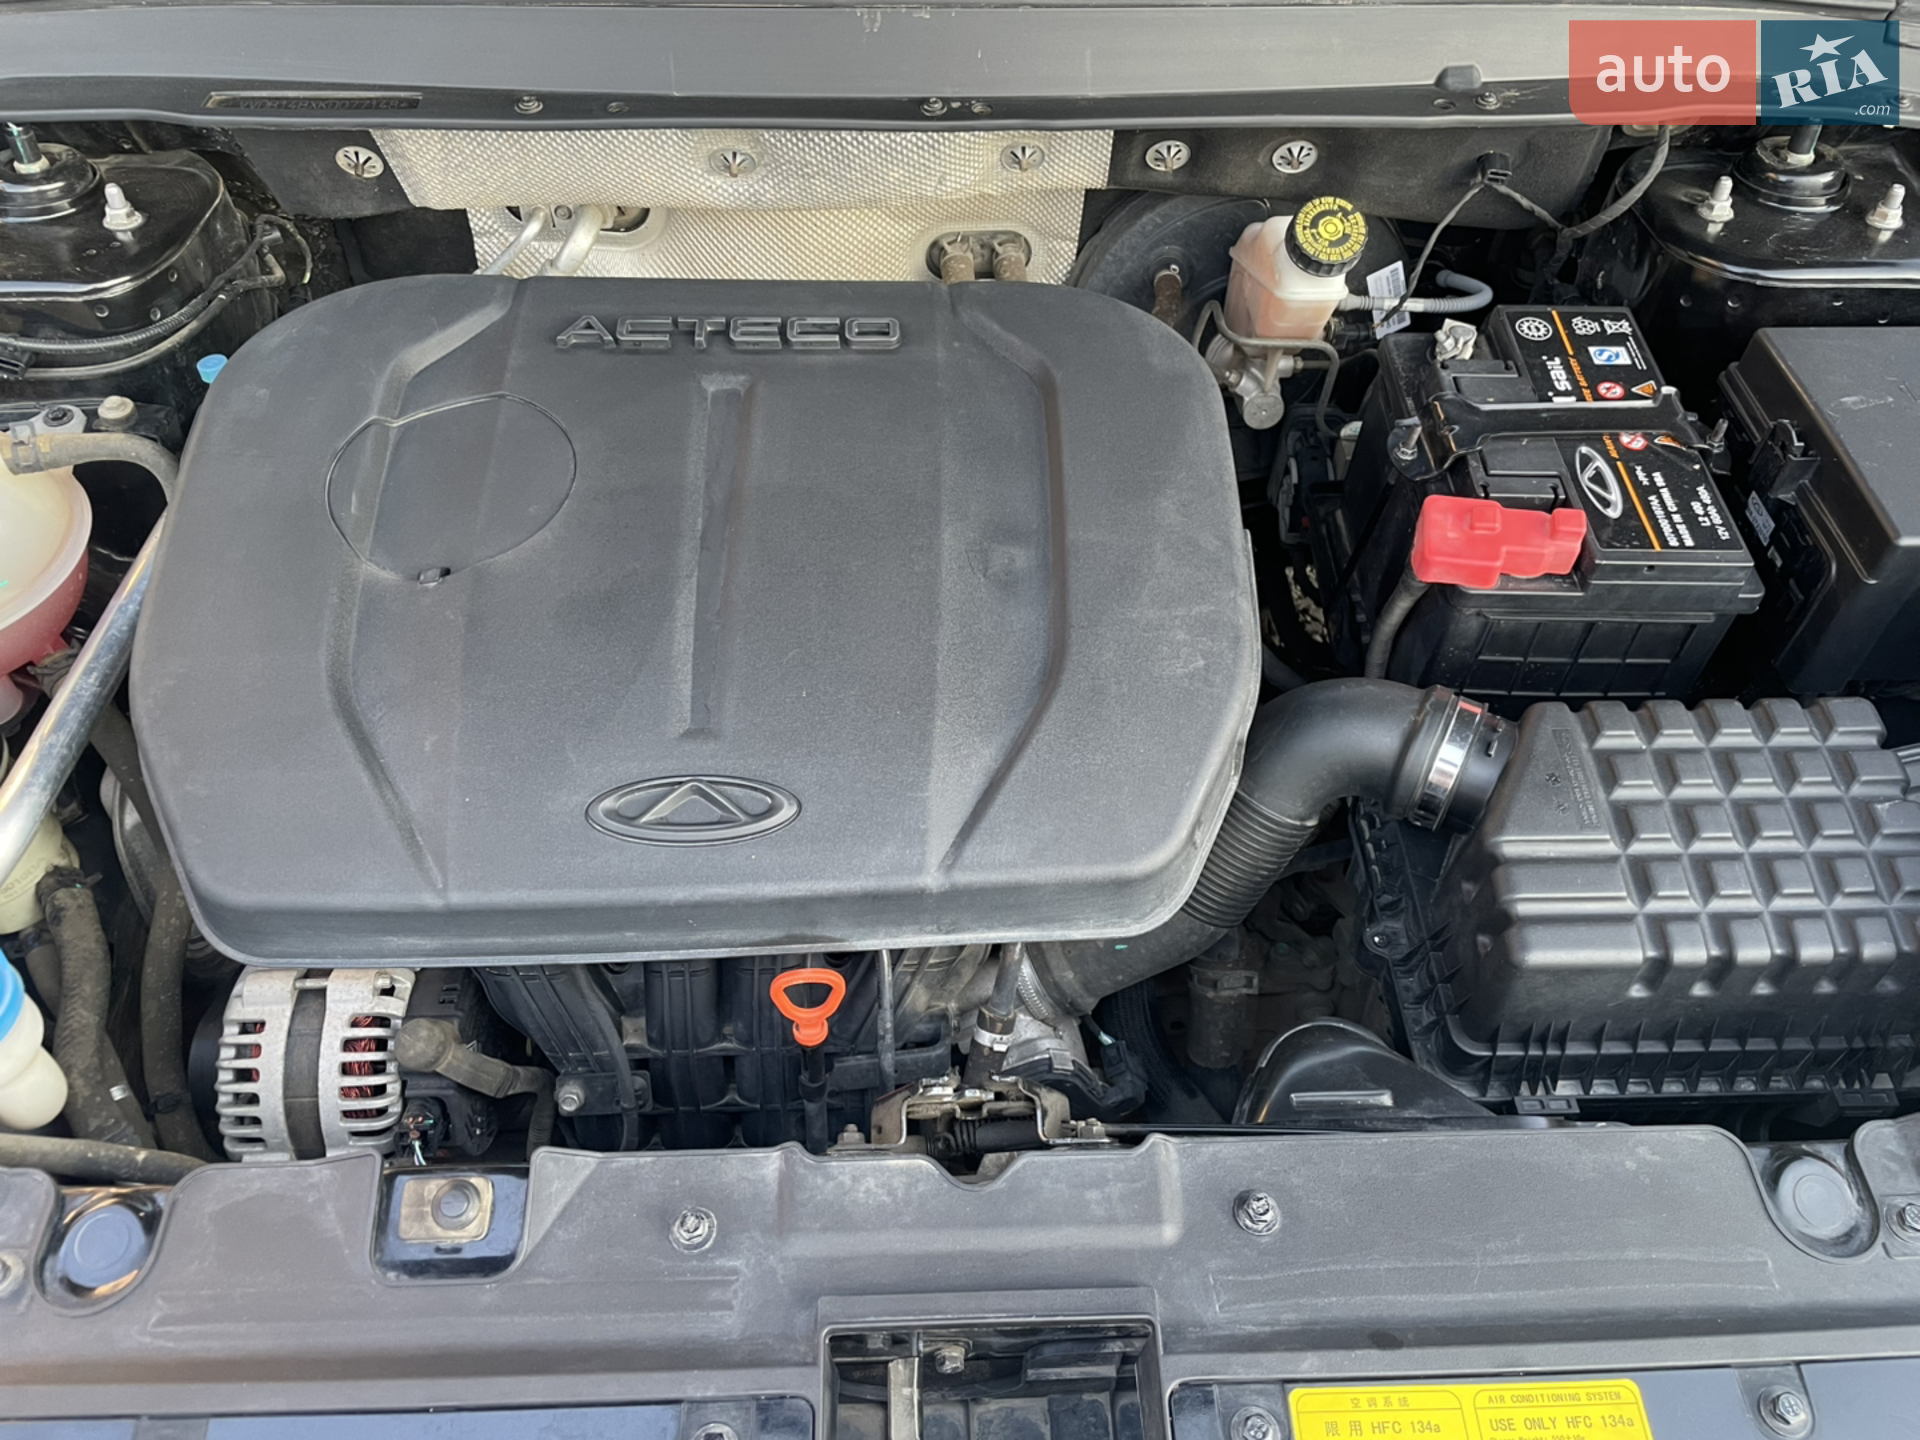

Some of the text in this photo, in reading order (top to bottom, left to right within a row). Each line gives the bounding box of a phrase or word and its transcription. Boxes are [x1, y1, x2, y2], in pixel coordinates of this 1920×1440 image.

[555, 314, 902, 351] ACTECO
[1659, 487, 1679, 513] CHINA
[1670, 513, 1684, 524] IN
[1675, 523, 1695, 548] MADE
[1715, 524, 1730, 540] 12V
[1350, 1396, 1410, 1409] 空调系统
[1488, 1391, 1622, 1405] AIR CONDITIONING SYSTEM
[1324, 1420, 1441, 1437] 限用 HFC 134a
[1489, 1414, 1634, 1432] USE ONLY HFC 134a
